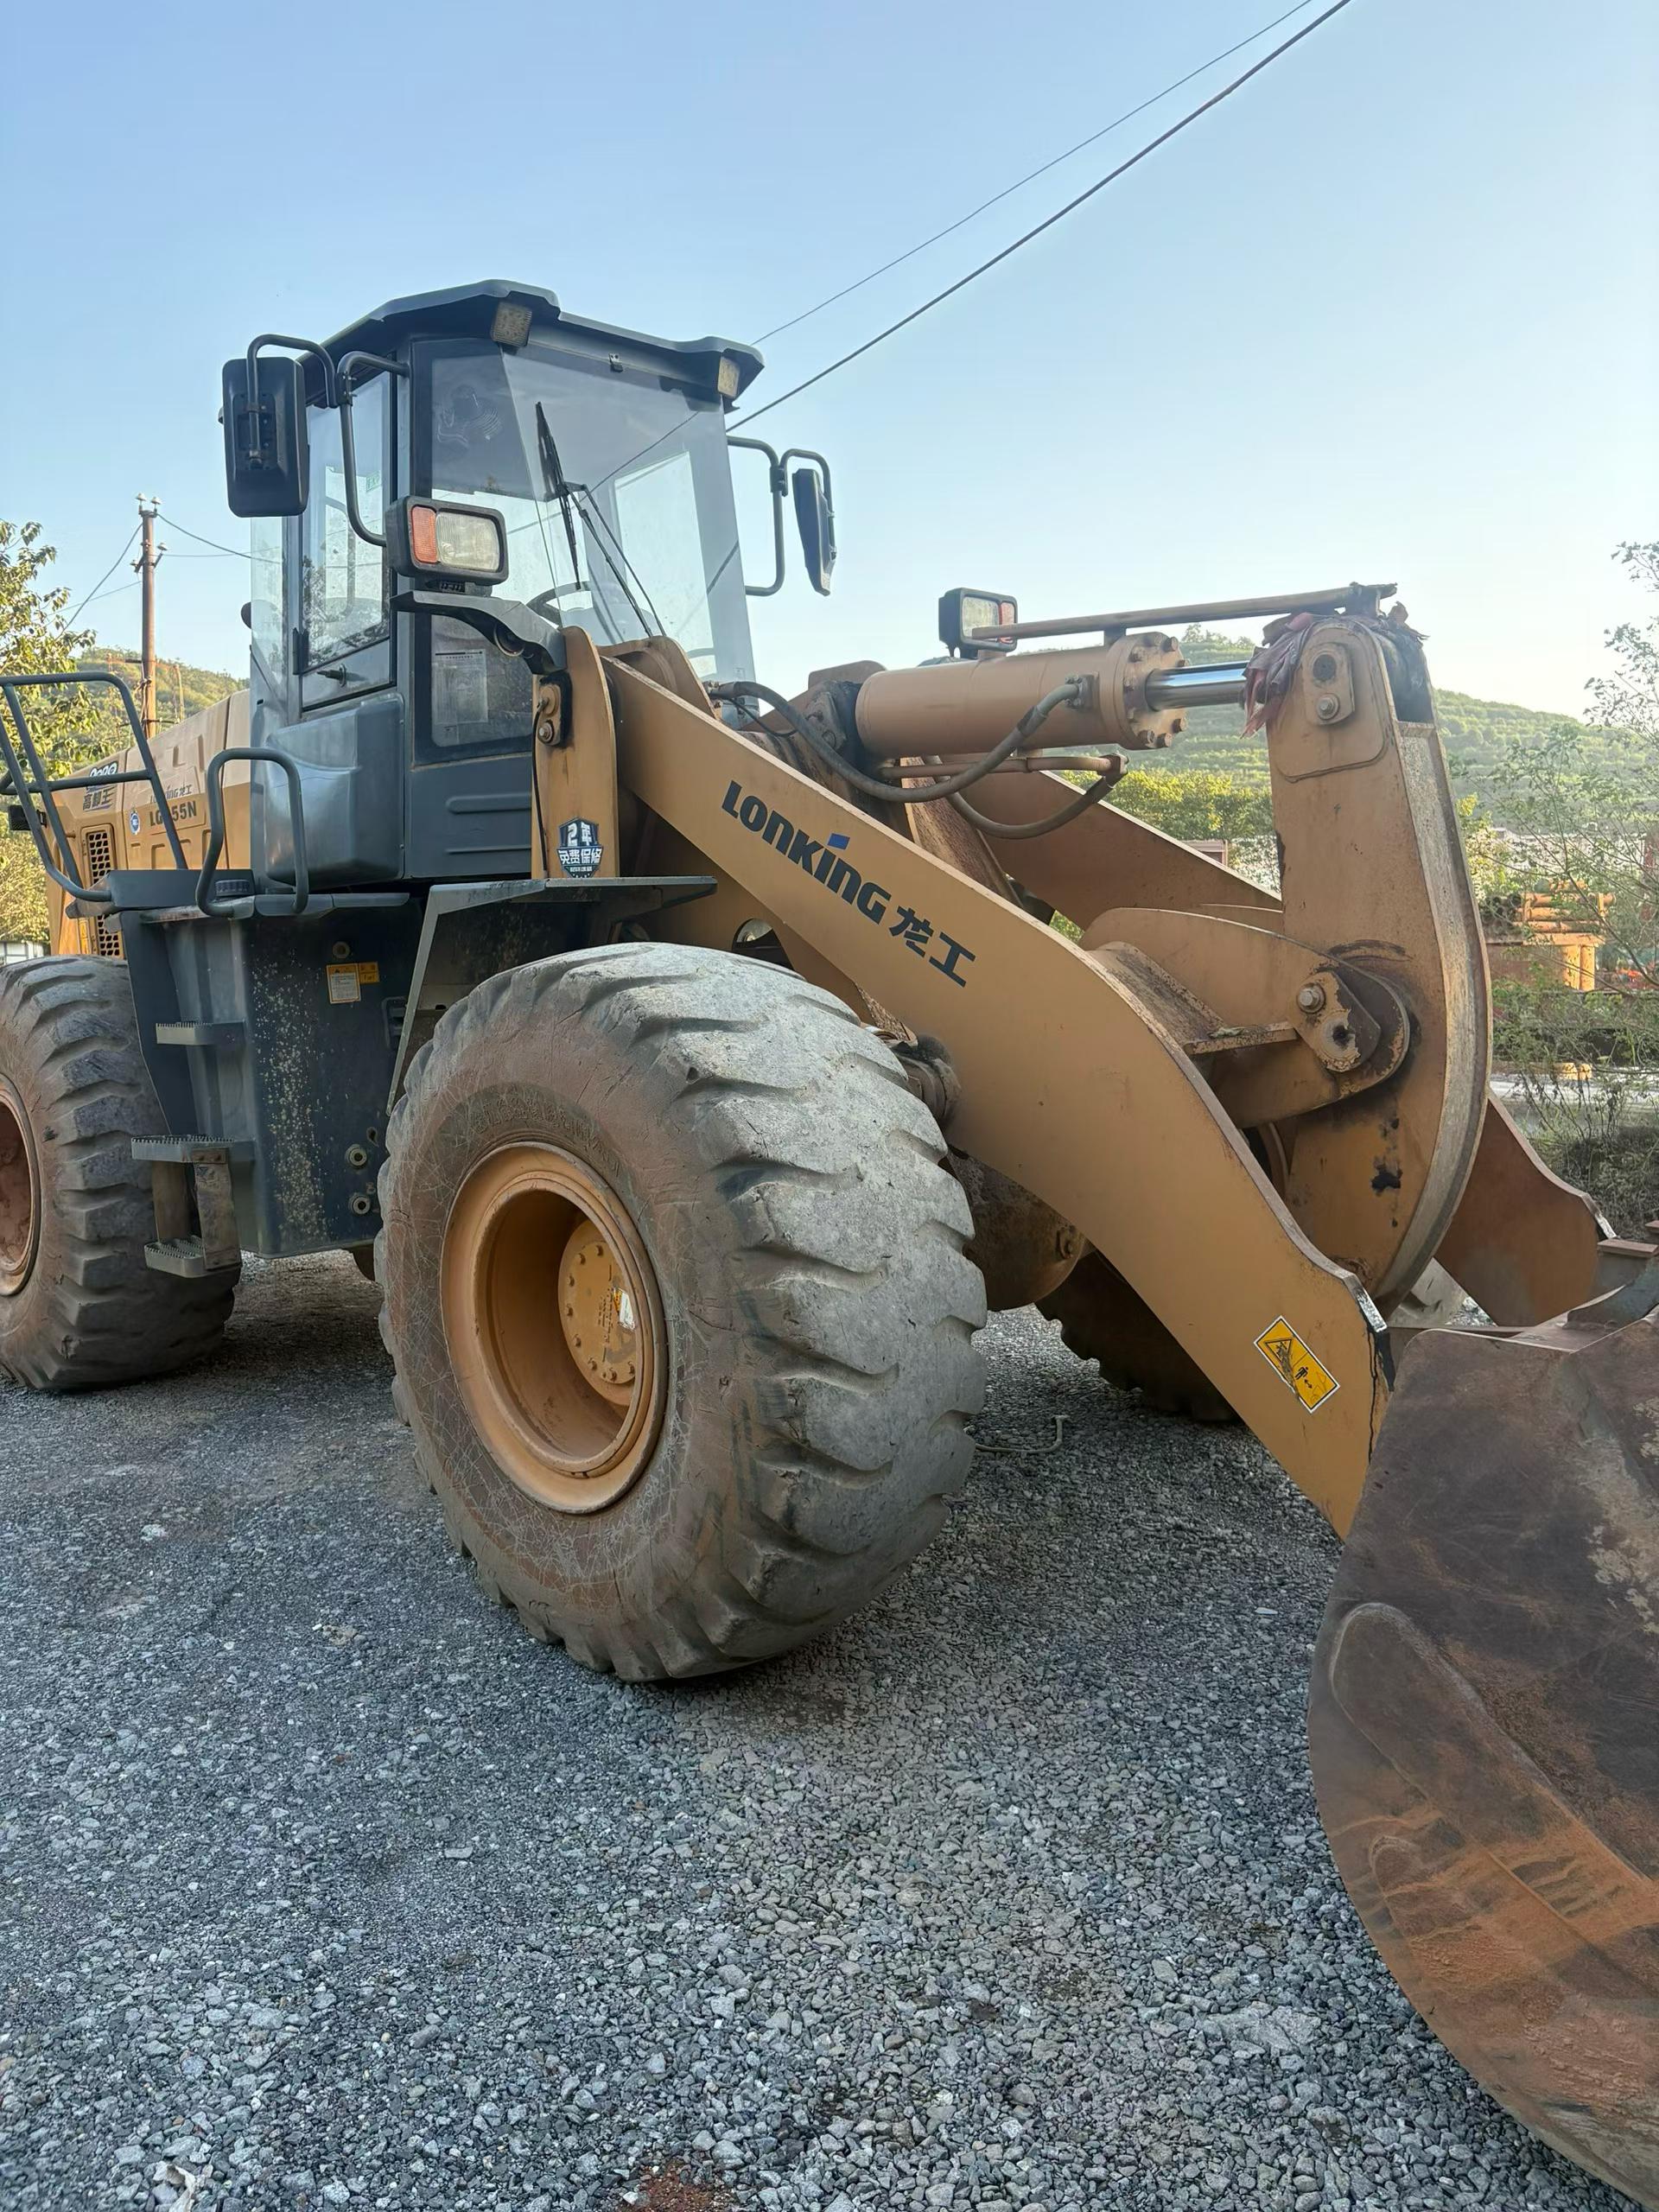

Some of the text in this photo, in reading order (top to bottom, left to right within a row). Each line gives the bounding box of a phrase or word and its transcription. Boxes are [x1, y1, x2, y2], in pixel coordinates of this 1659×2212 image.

[149, 800, 197, 826] LG55N
[558, 848, 602, 864] 免费保修
[721, 780, 976, 988] LONKING 龙工
